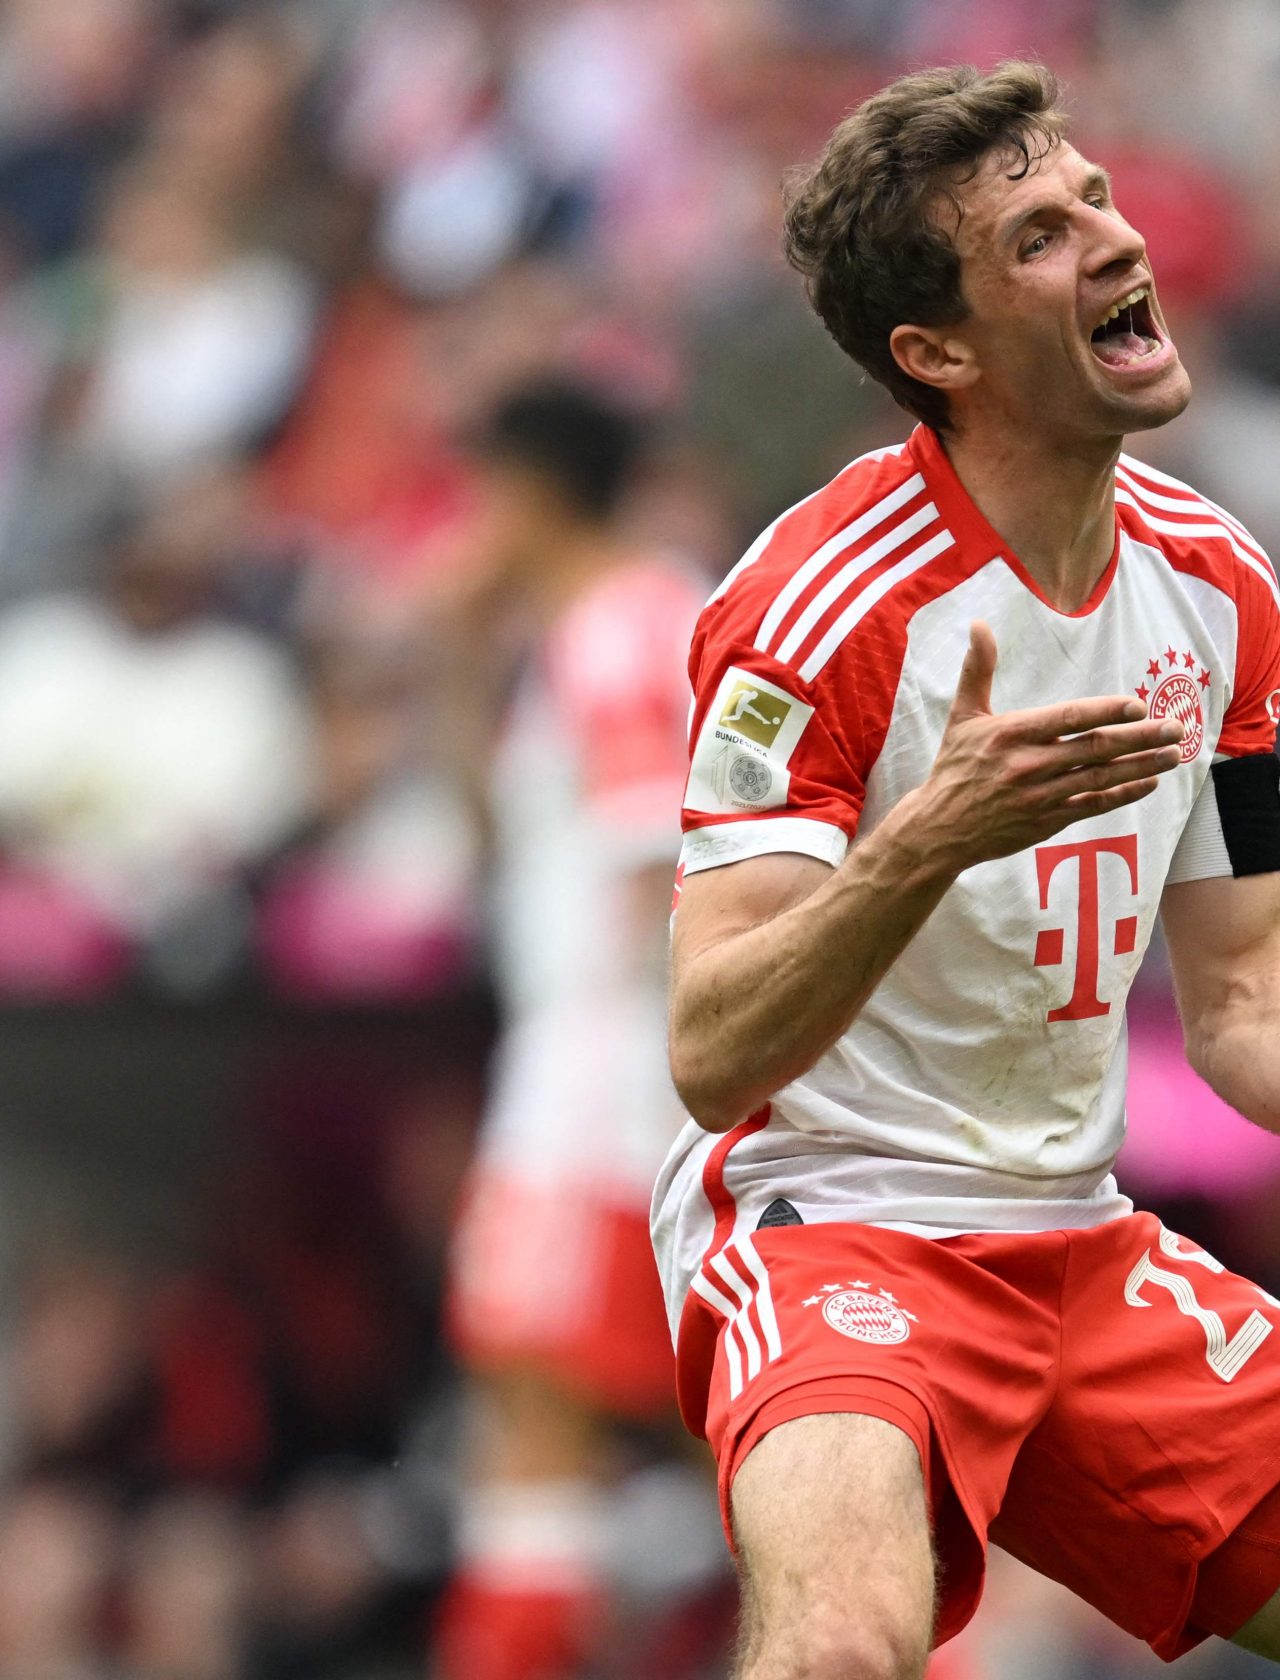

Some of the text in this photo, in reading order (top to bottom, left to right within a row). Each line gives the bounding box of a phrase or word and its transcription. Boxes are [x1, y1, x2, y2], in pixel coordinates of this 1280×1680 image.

[1155, 680, 1200, 717] FC BAYERN
[830, 1294, 901, 1321] FC BAYERN
